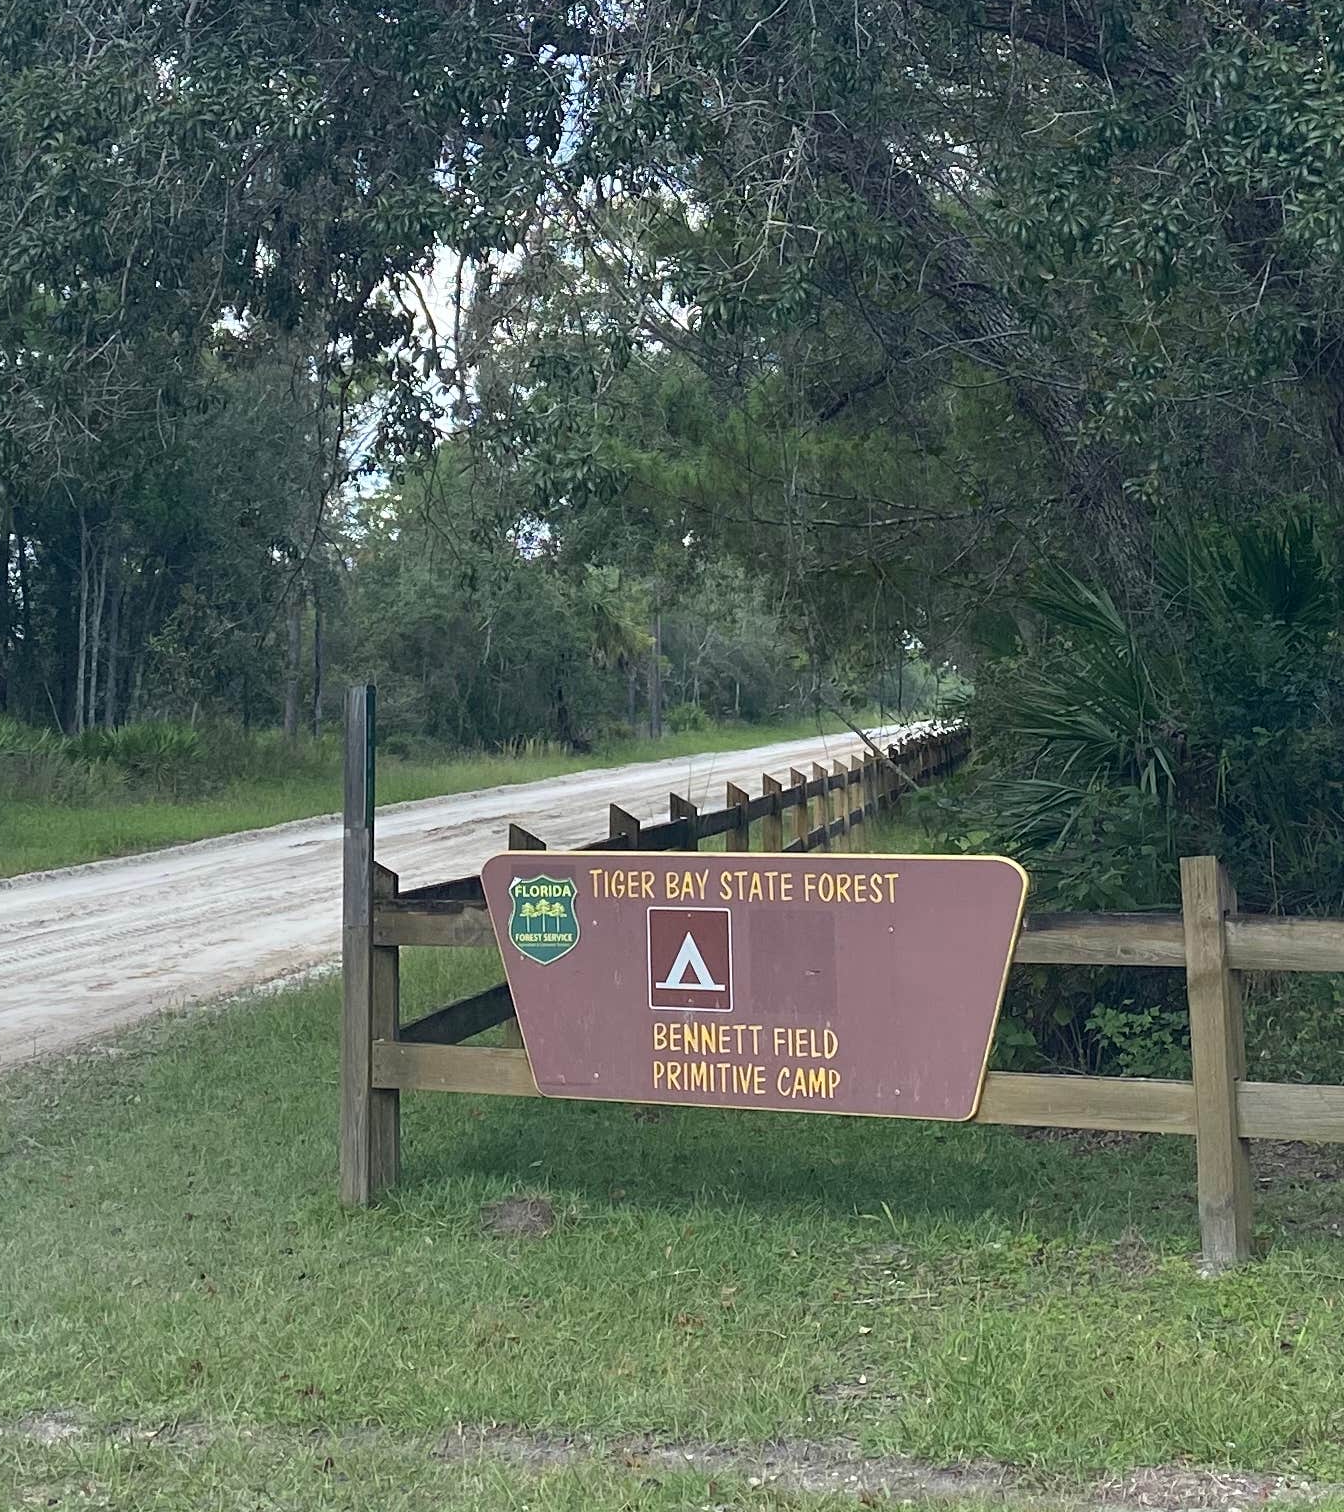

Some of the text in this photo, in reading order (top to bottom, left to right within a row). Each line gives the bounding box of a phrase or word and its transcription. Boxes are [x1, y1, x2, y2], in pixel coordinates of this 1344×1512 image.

[514, 885, 572, 898] FLORIDA
[589, 868, 899, 904] TIGER BAY STATE FOREST
[516, 933, 573, 942] FOREST SERVICE
[653, 1023, 839, 1060] BENNETT FIELD
[653, 1061, 841, 1099] PRIMITIVE CAMP
